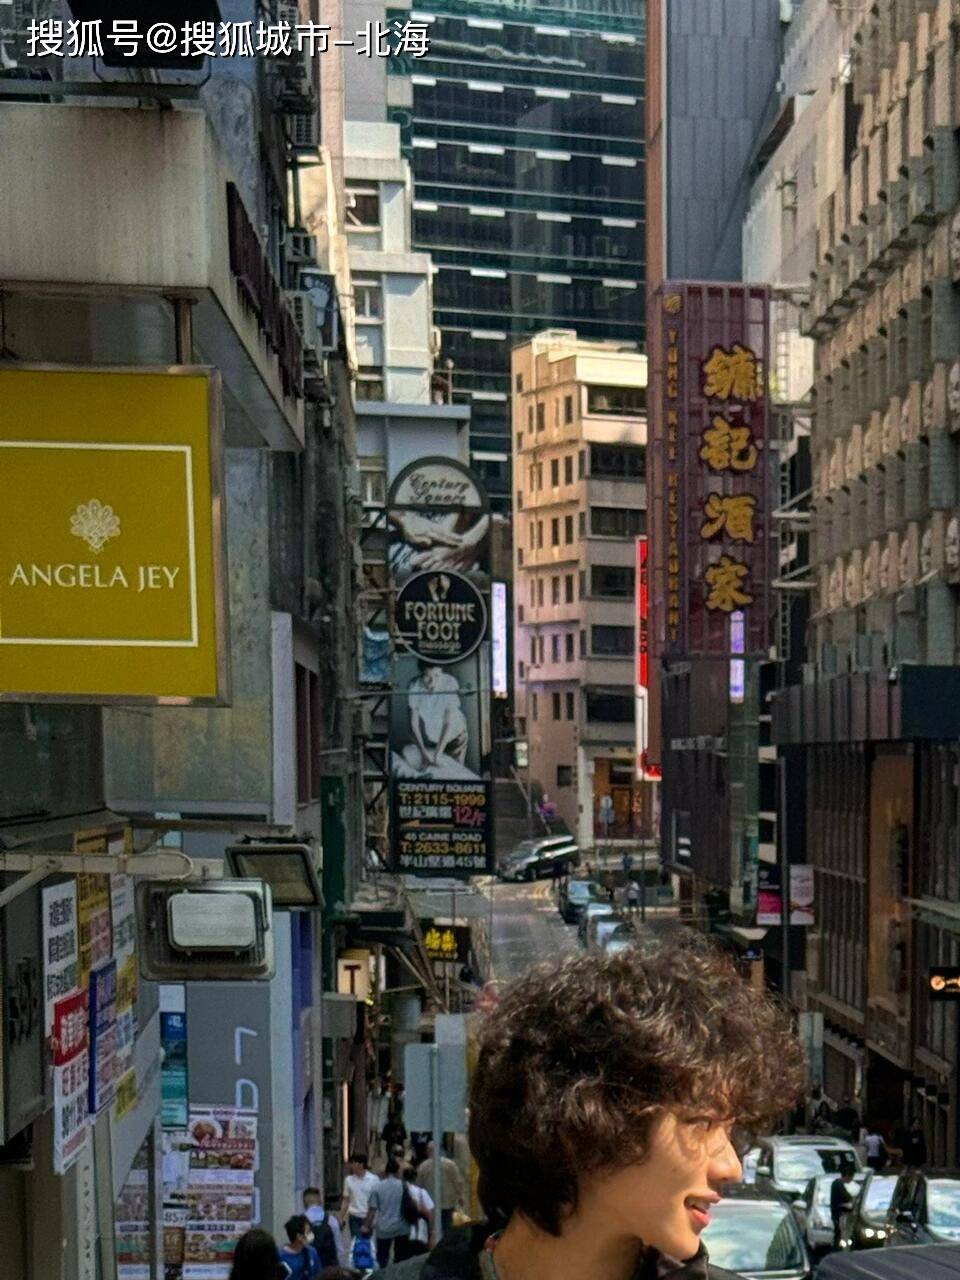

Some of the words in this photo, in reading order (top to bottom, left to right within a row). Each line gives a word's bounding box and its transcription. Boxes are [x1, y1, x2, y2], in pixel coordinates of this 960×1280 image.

[9, 563, 129, 588] ANGELA
[137, 566, 180, 592] JEY
[404, 601, 476, 623] FORTUNE
[416, 622, 462, 641] FOOT
[452, 833, 482, 841] ROAD
